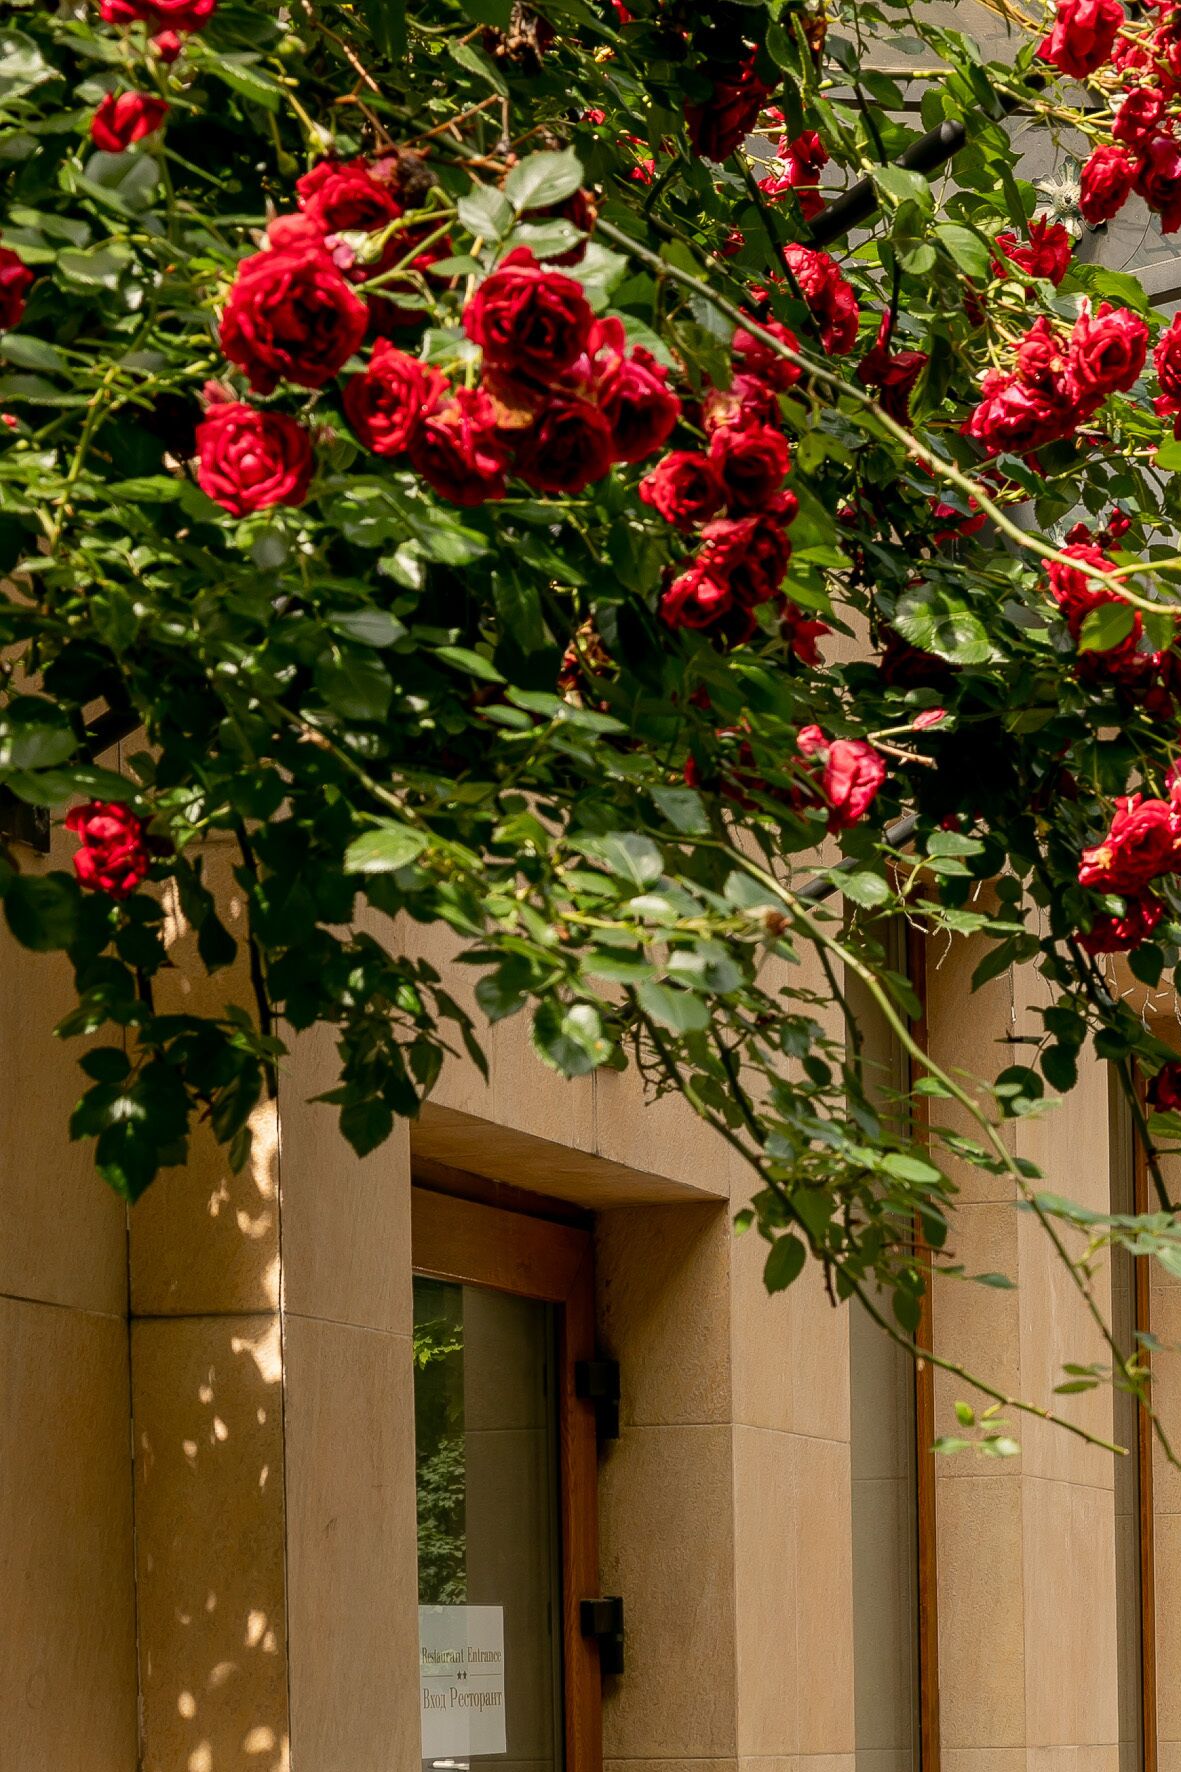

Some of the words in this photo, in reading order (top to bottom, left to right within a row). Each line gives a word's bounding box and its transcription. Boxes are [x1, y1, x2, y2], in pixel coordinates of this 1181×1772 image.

[422, 1647, 464, 1664] Restaurant
[467, 1646, 502, 1663] Entrance
[423, 1688, 446, 1711] Вход
[450, 1687, 502, 1712] Ресторант
